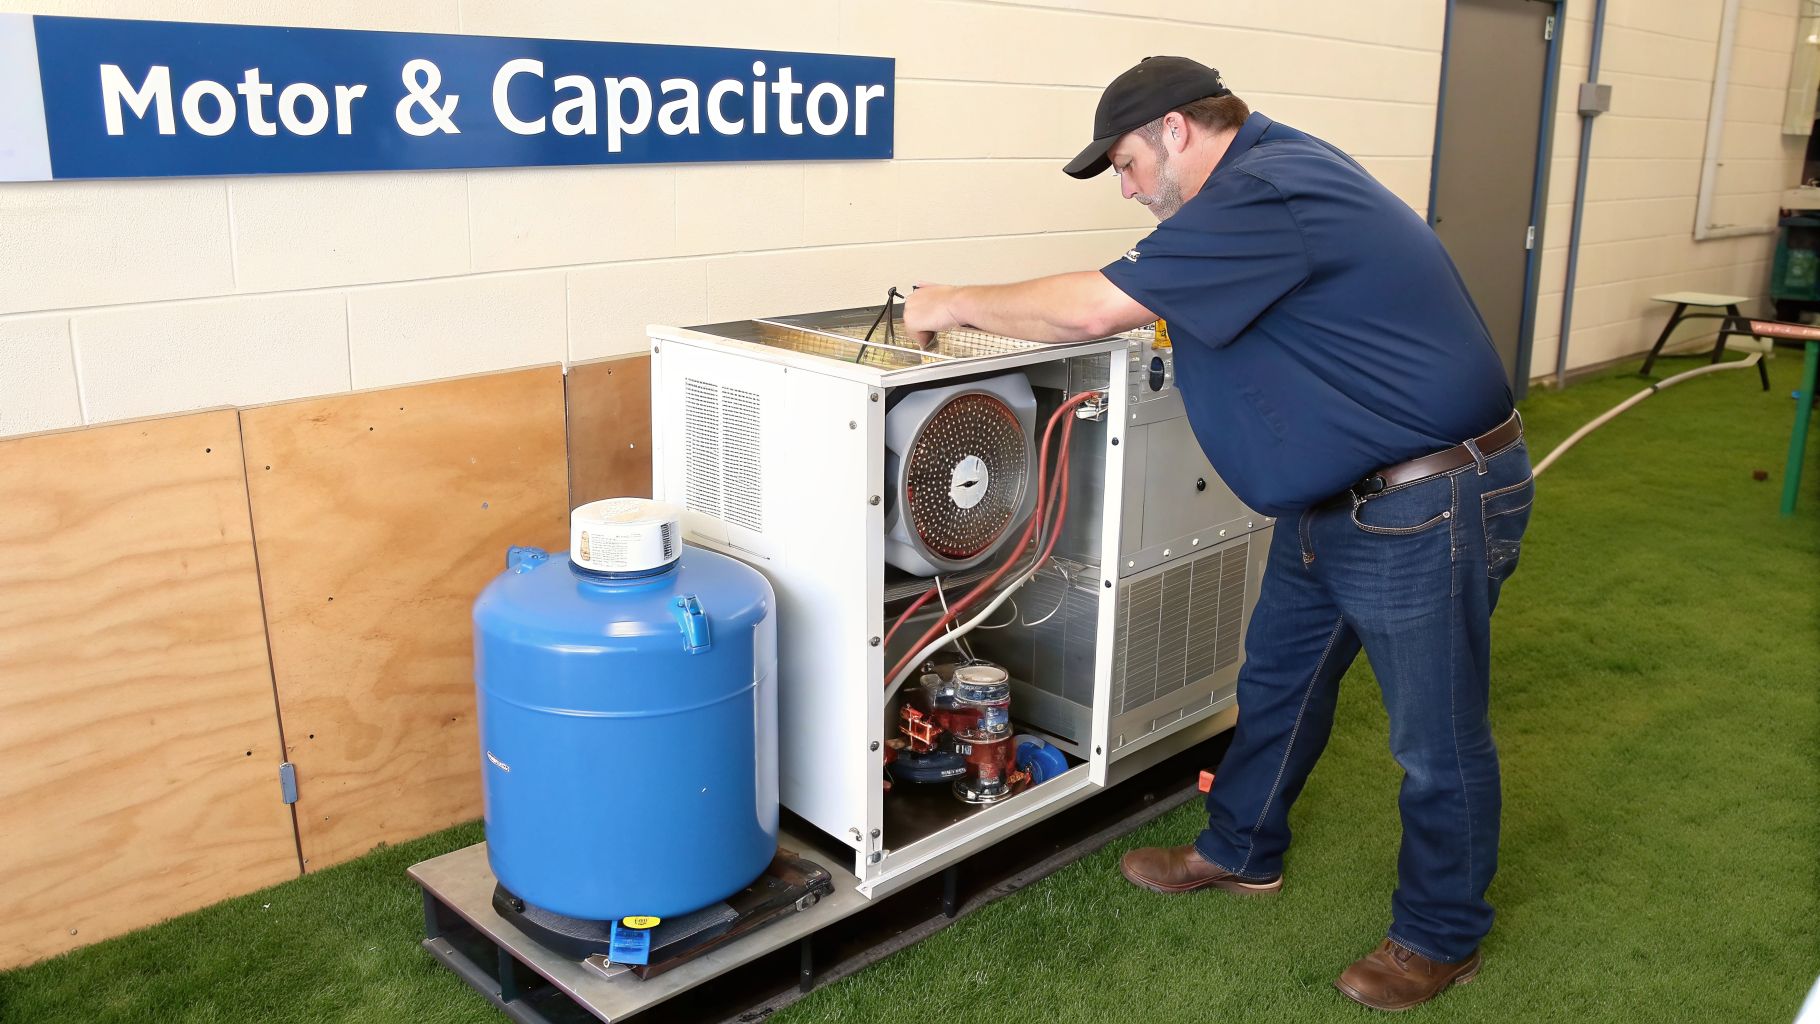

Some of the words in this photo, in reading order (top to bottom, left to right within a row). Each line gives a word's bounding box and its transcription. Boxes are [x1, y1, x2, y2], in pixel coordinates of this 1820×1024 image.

[99, 63, 368, 136] Motor
[395, 58, 462, 137] &
[492, 58, 886, 153] Capacitor
